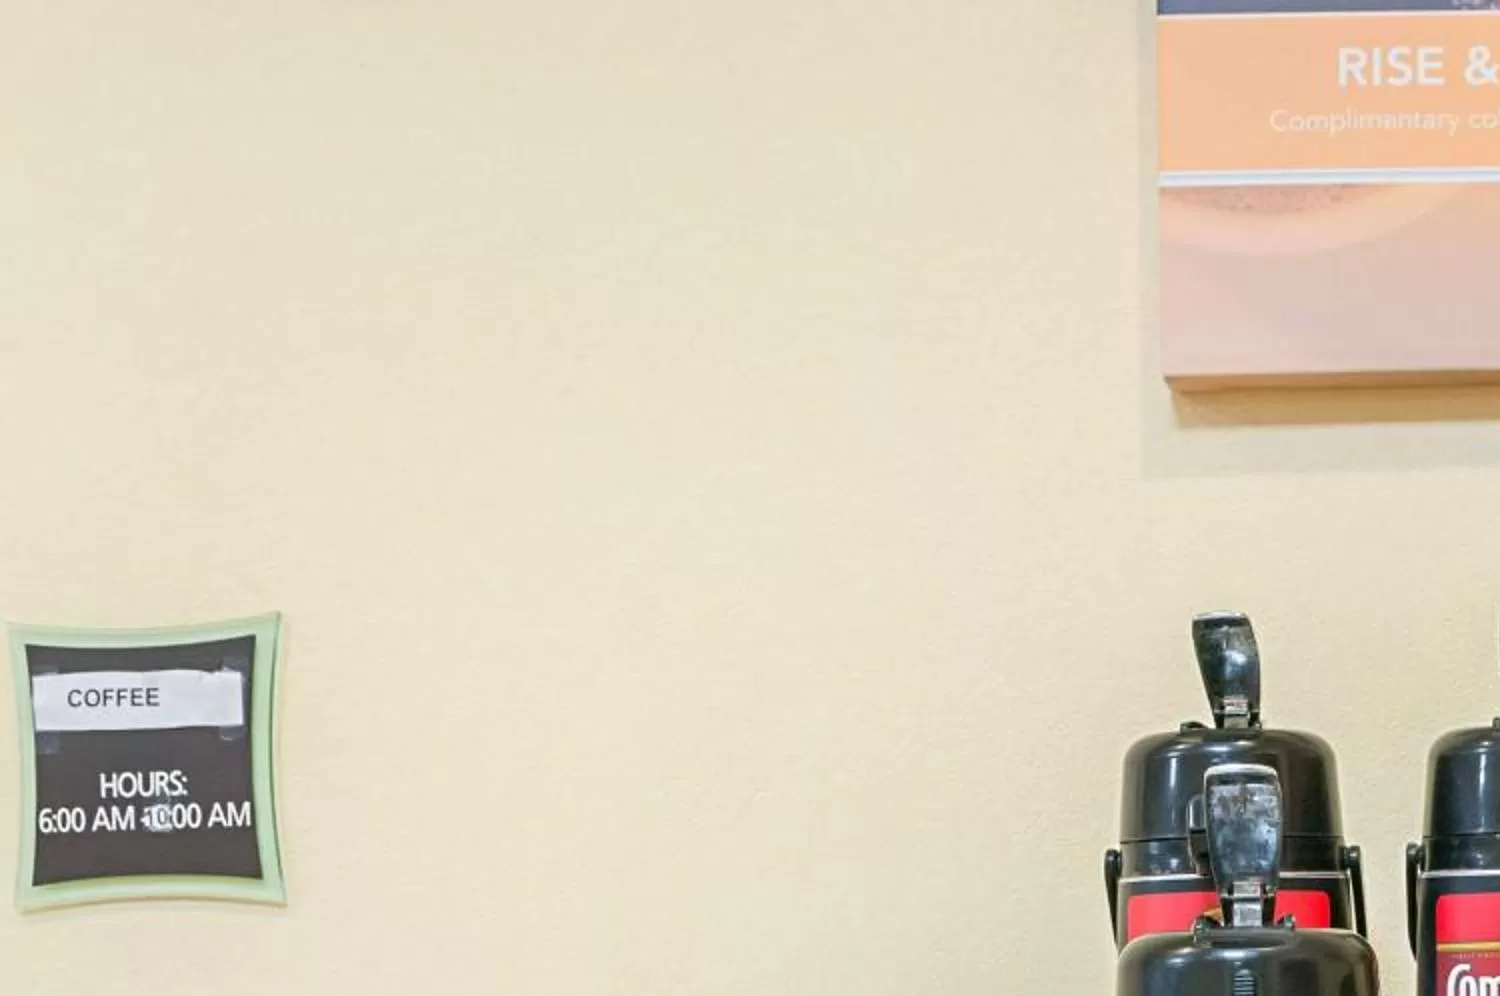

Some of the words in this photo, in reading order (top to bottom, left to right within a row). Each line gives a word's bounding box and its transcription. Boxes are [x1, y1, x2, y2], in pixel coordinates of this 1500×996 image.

[1336, 46, 1445, 88] RISE
[1463, 46, 1500, 87] &
[1268, 107, 1460, 138] Complimentary
[66, 687, 160, 708] COFFEE
[99, 770, 188, 799] HOURS:
[38, 807, 86, 834] 6:00
[92, 805, 136, 832] AM
[207, 801, 251, 828] AM
